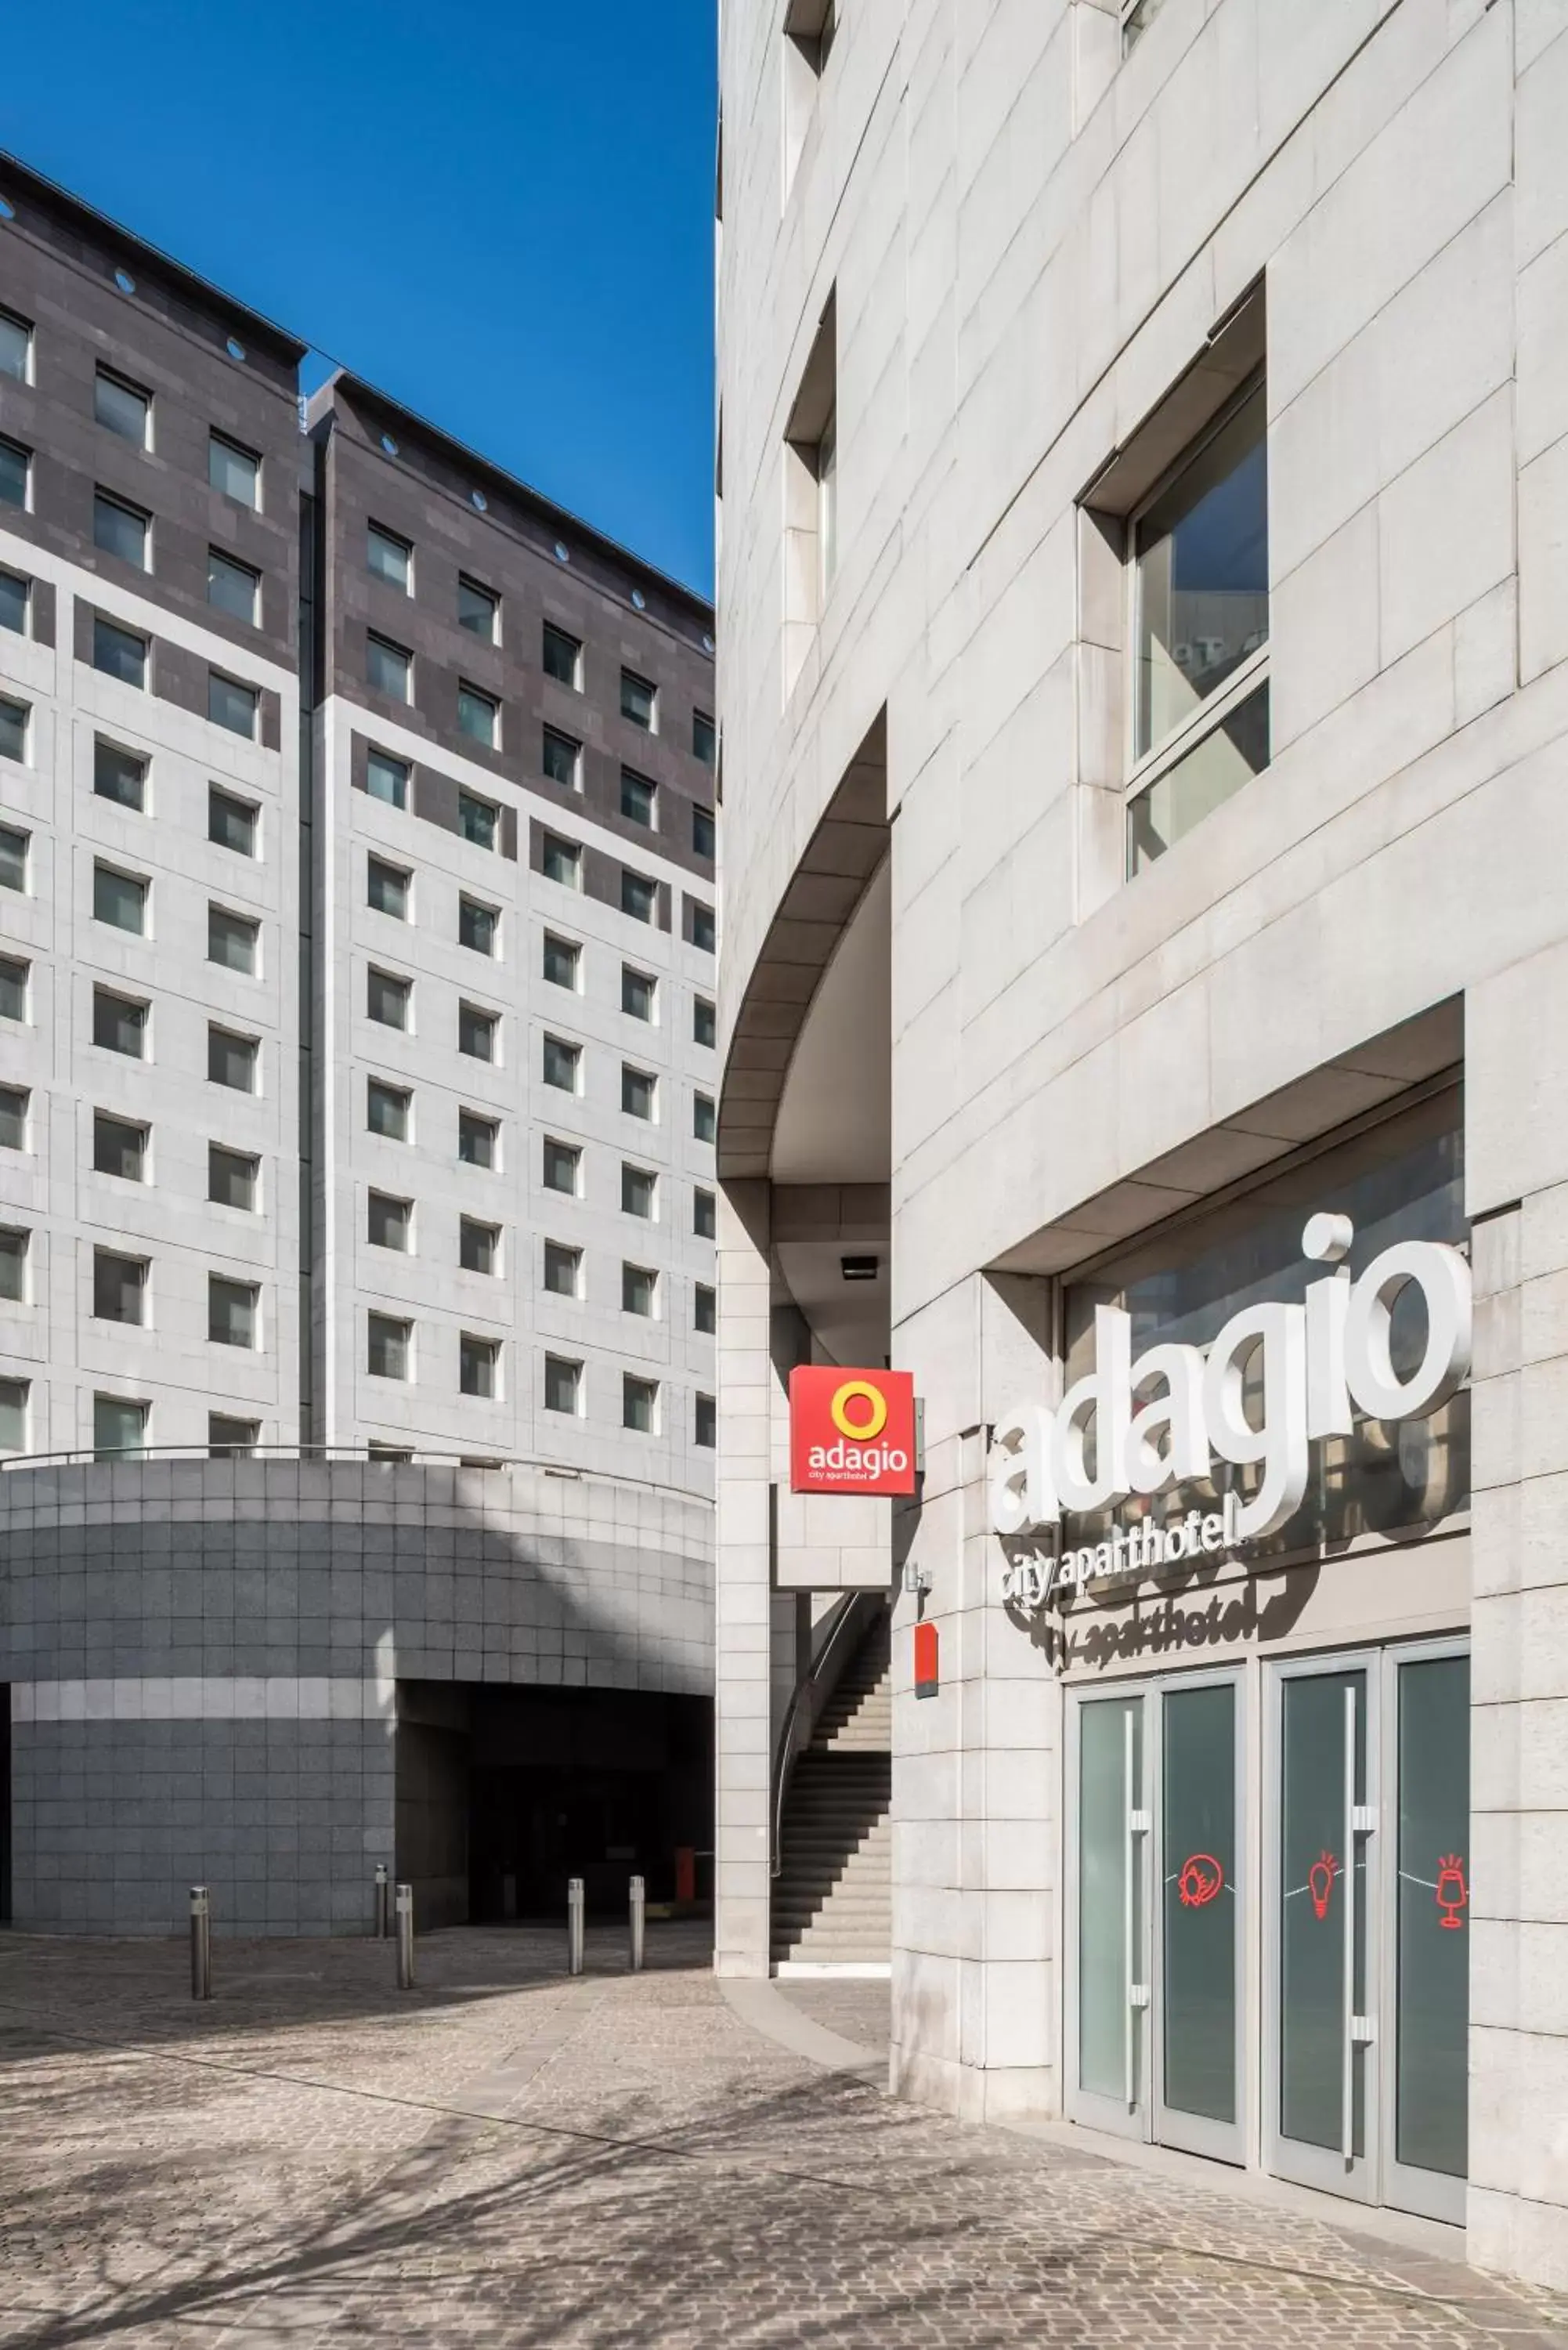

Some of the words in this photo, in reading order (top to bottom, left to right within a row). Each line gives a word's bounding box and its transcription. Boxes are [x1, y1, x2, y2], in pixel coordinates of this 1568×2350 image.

[989, 1212, 1471, 1538] adagio
[808, 1438, 908, 1480] adagio
[808, 1470, 824, 1480] city
[1001, 1549, 1057, 1606] city
[1059, 1490, 1241, 1596] aparthotel
